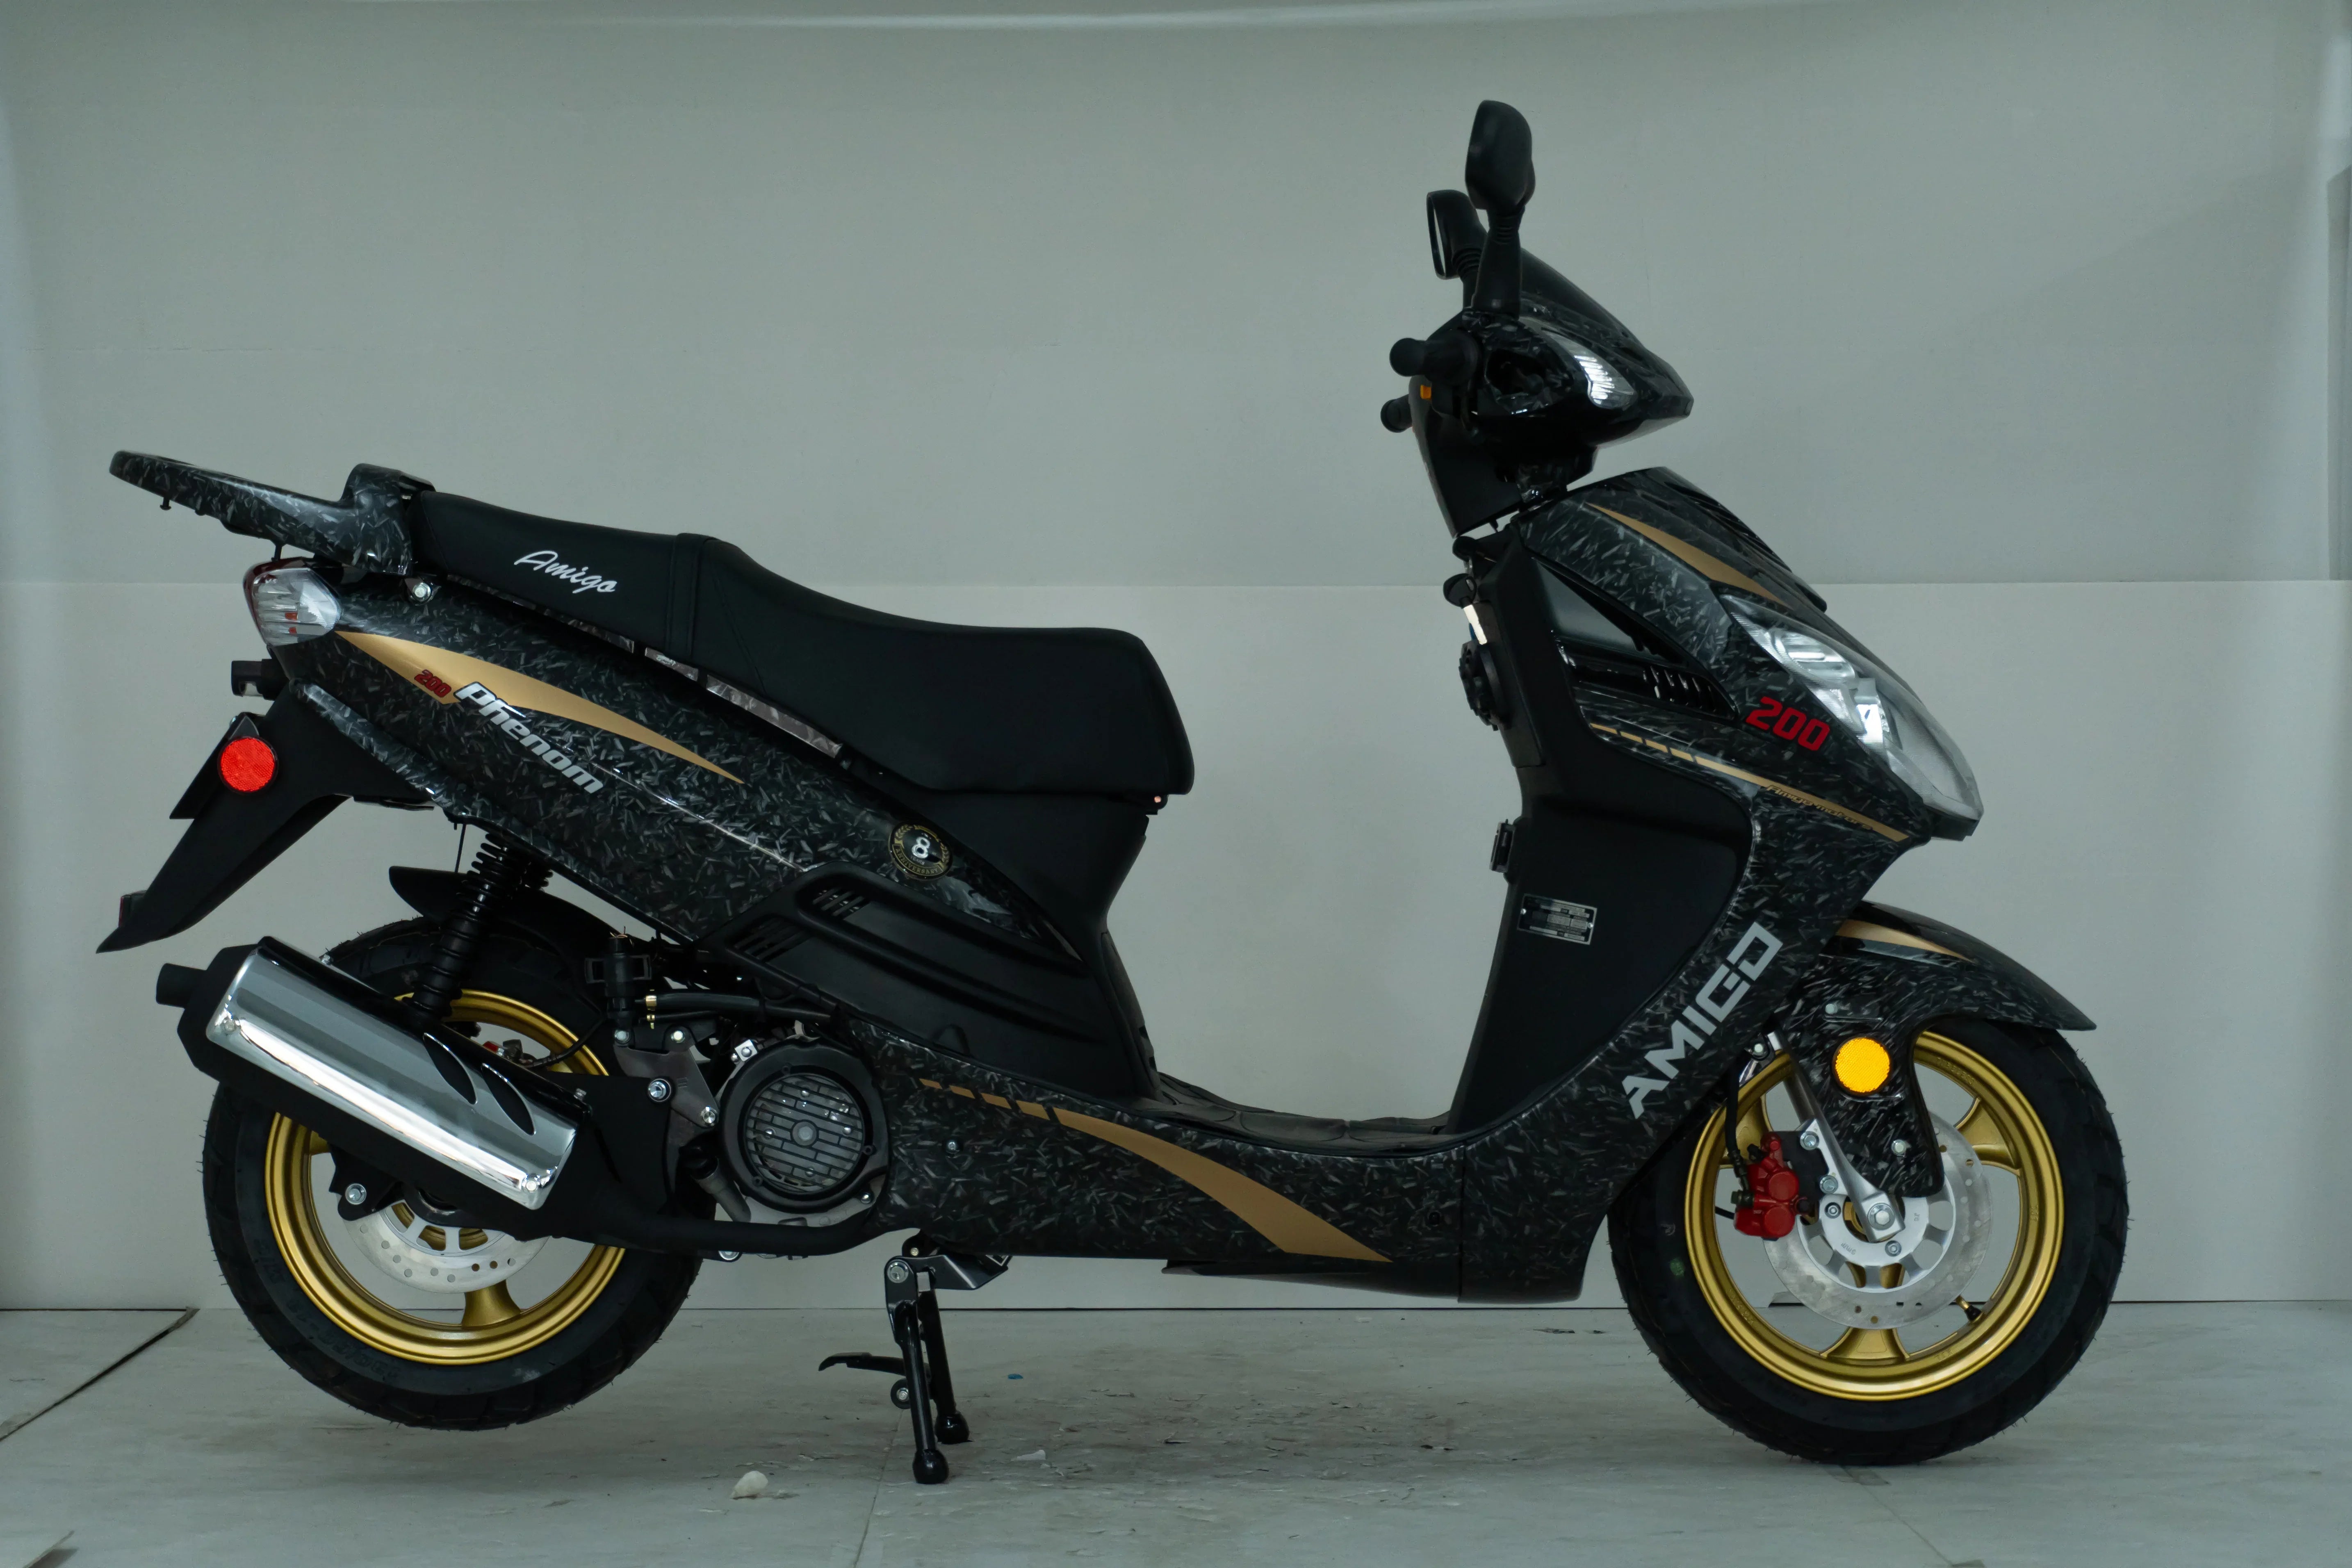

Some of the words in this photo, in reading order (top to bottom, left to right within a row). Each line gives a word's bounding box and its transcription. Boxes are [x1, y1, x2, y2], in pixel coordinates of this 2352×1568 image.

[514, 550, 618, 594] Amigo
[414, 669, 451, 697] 200
[454, 681, 604, 793] Phenom
[1746, 696, 1830, 751] 200
[1766, 785, 1813, 806] Amigo
[895, 848, 938, 874] ANNIVERSARY
[912, 836, 930, 859] 8
[1622, 921, 1784, 1119] AMIGO
